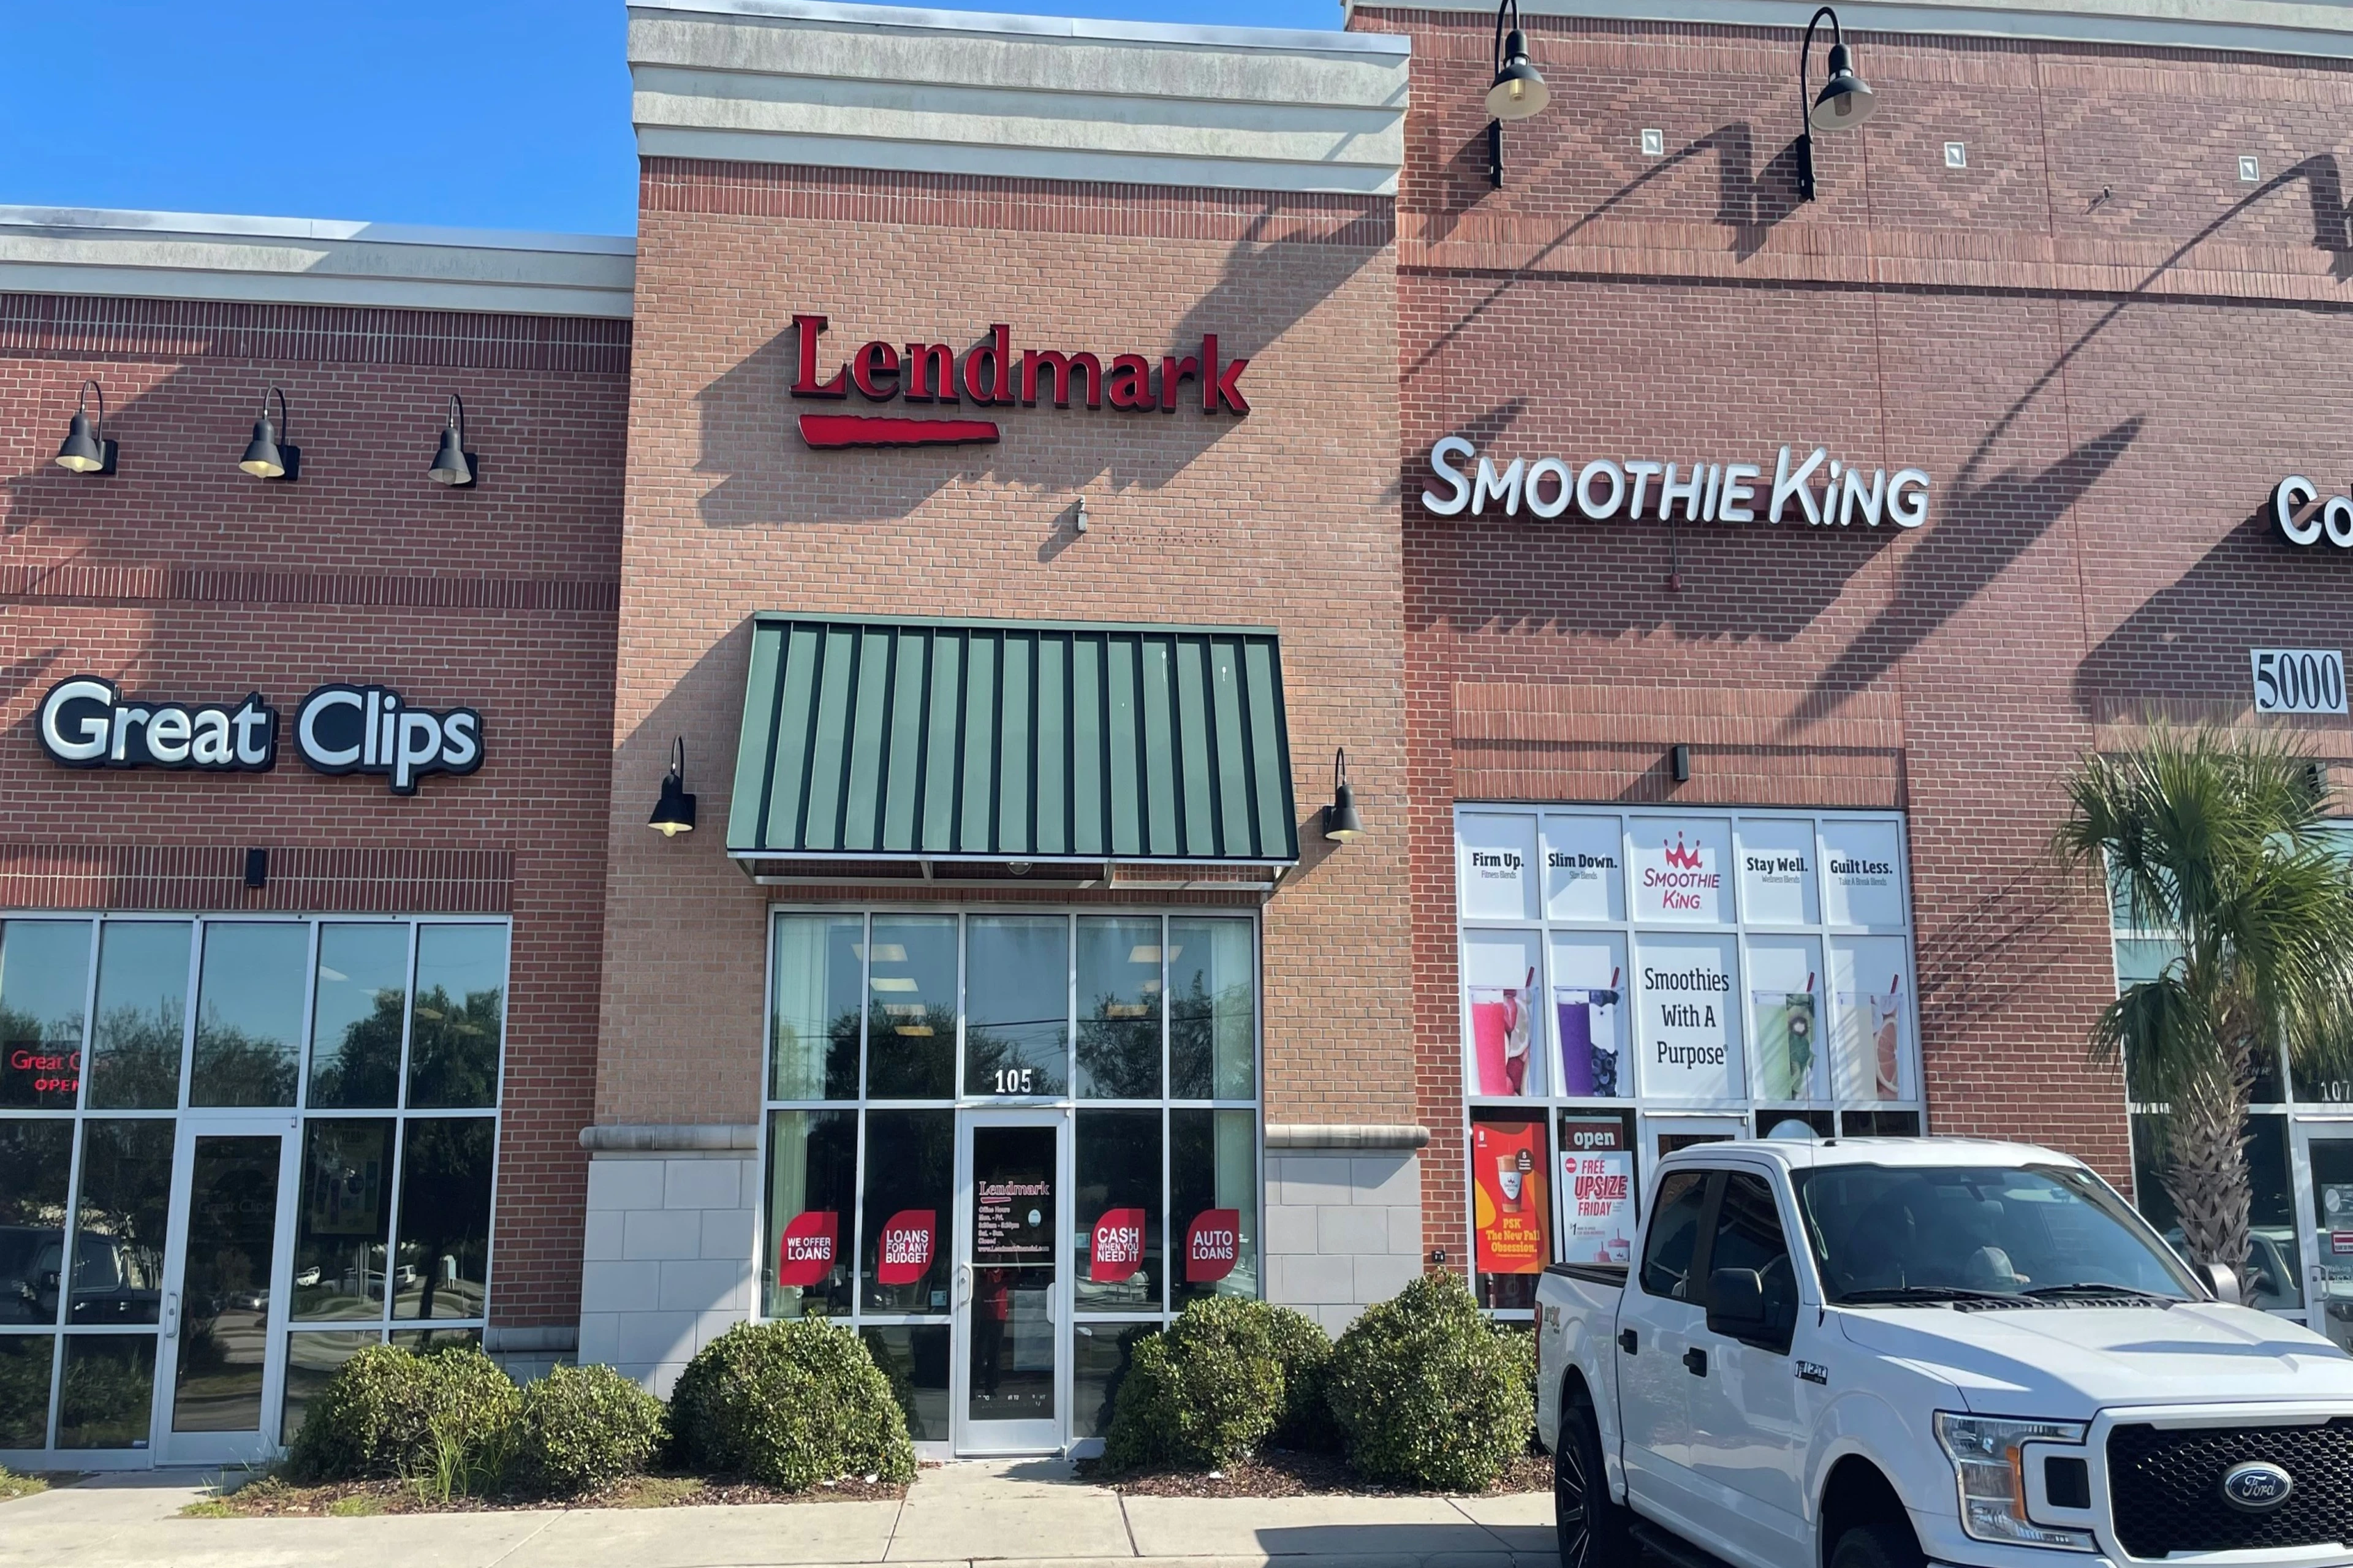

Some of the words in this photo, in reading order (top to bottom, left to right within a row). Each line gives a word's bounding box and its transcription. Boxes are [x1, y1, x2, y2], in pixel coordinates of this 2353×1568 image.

[790, 315, 1250, 415] Lendmark
[1422, 436, 1760, 523] SMOOTHIE
[2257, 653, 2341, 710] 5000
[42, 681, 267, 765] Great
[299, 690, 476, 787] Clips
[1472, 852, 1501, 867] Firm
[1504, 854, 1525, 870] Up.
[1548, 853, 1576, 868] Slim
[1578, 854, 1618, 868] Down.
[1746, 857, 1775, 874] Stay
[1777, 858, 1808, 872] Well.
[1830, 859, 1860, 874] Guilt
[1862, 860, 1893, 874] Less.
[1481, 870, 1499, 879] Fitness
[1643, 868, 1721, 888] SMOOTHIE
[1645, 968, 1729, 991] Smoothies
[1661, 1004, 1700, 1027] With
[1704, 1006, 1716, 1027] A
[11, 1050, 64, 1070] Great
[1657, 1041, 1724, 1069] Purpose
[995, 1069, 1032, 1093] 105
[2321, 1080, 2351, 1102] 107
[1574, 1132, 1615, 1151] open
[1582, 1159, 1605, 1174] FREE
[979, 1181, 1050, 1196] Lendmark
[1574, 1175, 1628, 1200] UPSIZE
[1578, 1202, 1612, 1216] FRIDAY
[787, 1238, 801, 1247] WE
[803, 1237, 831, 1247] OFFER
[886, 1230, 928, 1243] LOANS
[1097, 1227, 1139, 1243] CASH
[1193, 1230, 1233, 1246] AUTO
[1485, 1230, 1502, 1240] The
[1504, 1230, 1523, 1240] New
[1523, 1230, 1540, 1241] Fall
[787, 1247, 830, 1260] LOANS
[886, 1243, 906, 1253] FOR
[908, 1243, 928, 1252] ANY
[1097, 1243, 1121, 1251] WHEN
[1123, 1242, 1139, 1251] YOU
[1192, 1247, 1233, 1260] LOANS
[1491, 1241, 1537, 1252] Obsession.
[885, 1252, 928, 1263] BUDGET
[1097, 1251, 1126, 1262] NEED
[1129, 1251, 1139, 1262] IT
[2242, 1475, 2276, 1497] Ford
